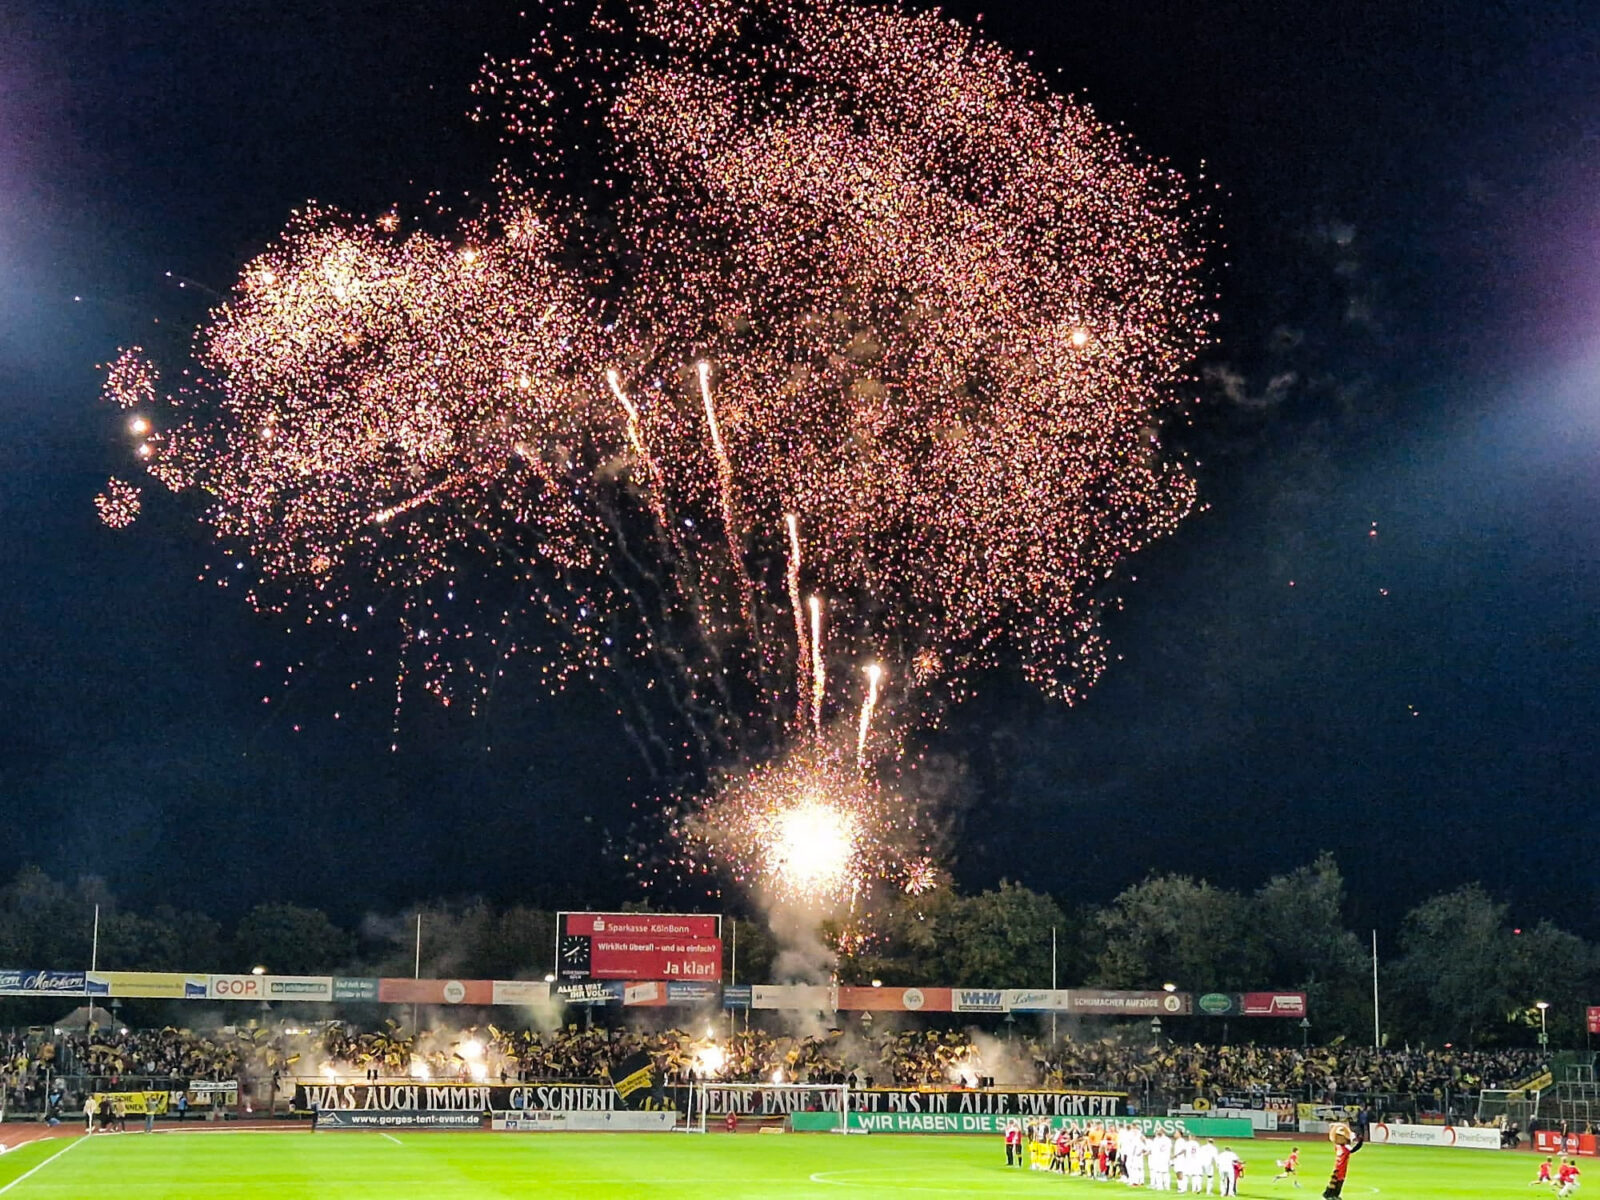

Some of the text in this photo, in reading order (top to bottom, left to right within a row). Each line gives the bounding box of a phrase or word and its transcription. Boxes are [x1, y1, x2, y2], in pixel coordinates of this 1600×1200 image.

[608, 924, 690, 933] Sparkasse KölnBonn
[598, 943, 627, 951] Wirklich
[629, 943, 654, 952] überall
[661, 944, 675, 952] und
[686, 944, 716, 953] einfach?
[663, 961, 715, 975] Ja klar!
[961, 992, 1001, 1005] WHM
[1074, 998, 1159, 1007] SCHUMACHER AUFZÜGE
[304, 1085, 356, 1110] WAS
[365, 1085, 419, 1110] AUCH
[426, 1086, 493, 1111] IMMER
[696, 1089, 755, 1114] DEINE
[929, 1093, 948, 1113] IN
[960, 1093, 1009, 1114] ALLE
[1018, 1093, 1120, 1116] EWIGKEIT
[352, 1114, 480, 1125] www.gorges-tent-event.de
[858, 1115, 893, 1130] WIR
[899, 1116, 958, 1130] HABEN
[963, 1116, 988, 1131] DIE
[1136, 1119, 1190, 1134] SPASS.
[1391, 1129, 1435, 1141] RheinEnergie
[1458, 1132, 1498, 1144] RheinEnergie
